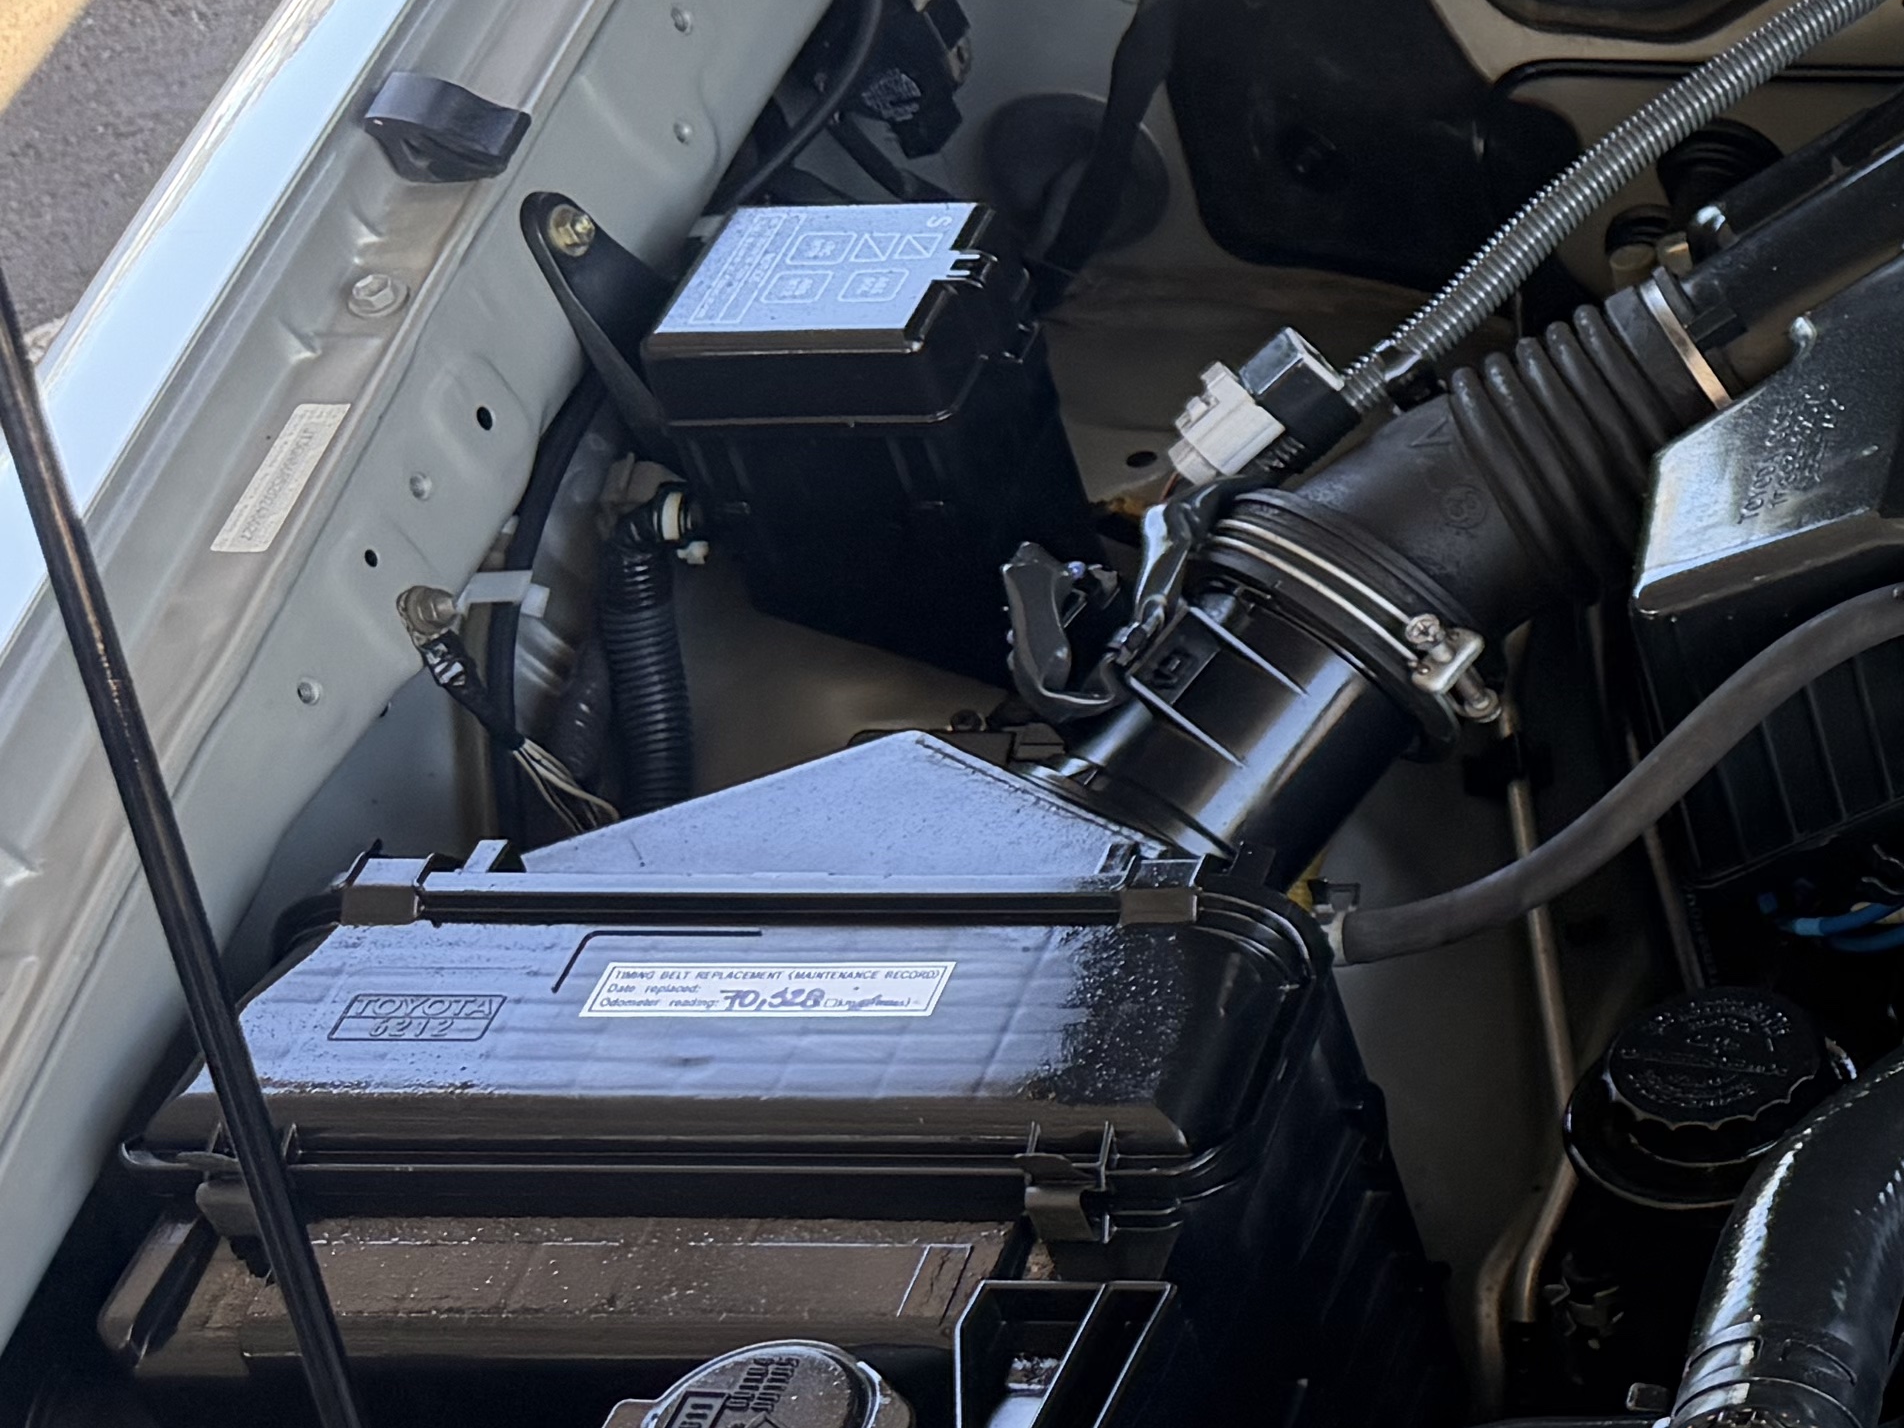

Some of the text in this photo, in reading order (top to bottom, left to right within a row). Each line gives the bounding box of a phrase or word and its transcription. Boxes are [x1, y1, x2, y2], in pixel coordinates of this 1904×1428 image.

[659, 970, 693, 980] BELT
[695, 970, 785, 980] REPLACEMENT
[606, 985, 702, 995] Date replaced:
[354, 998, 494, 1017] TOYOTA
[599, 997, 720, 1010] Odometer reading:
